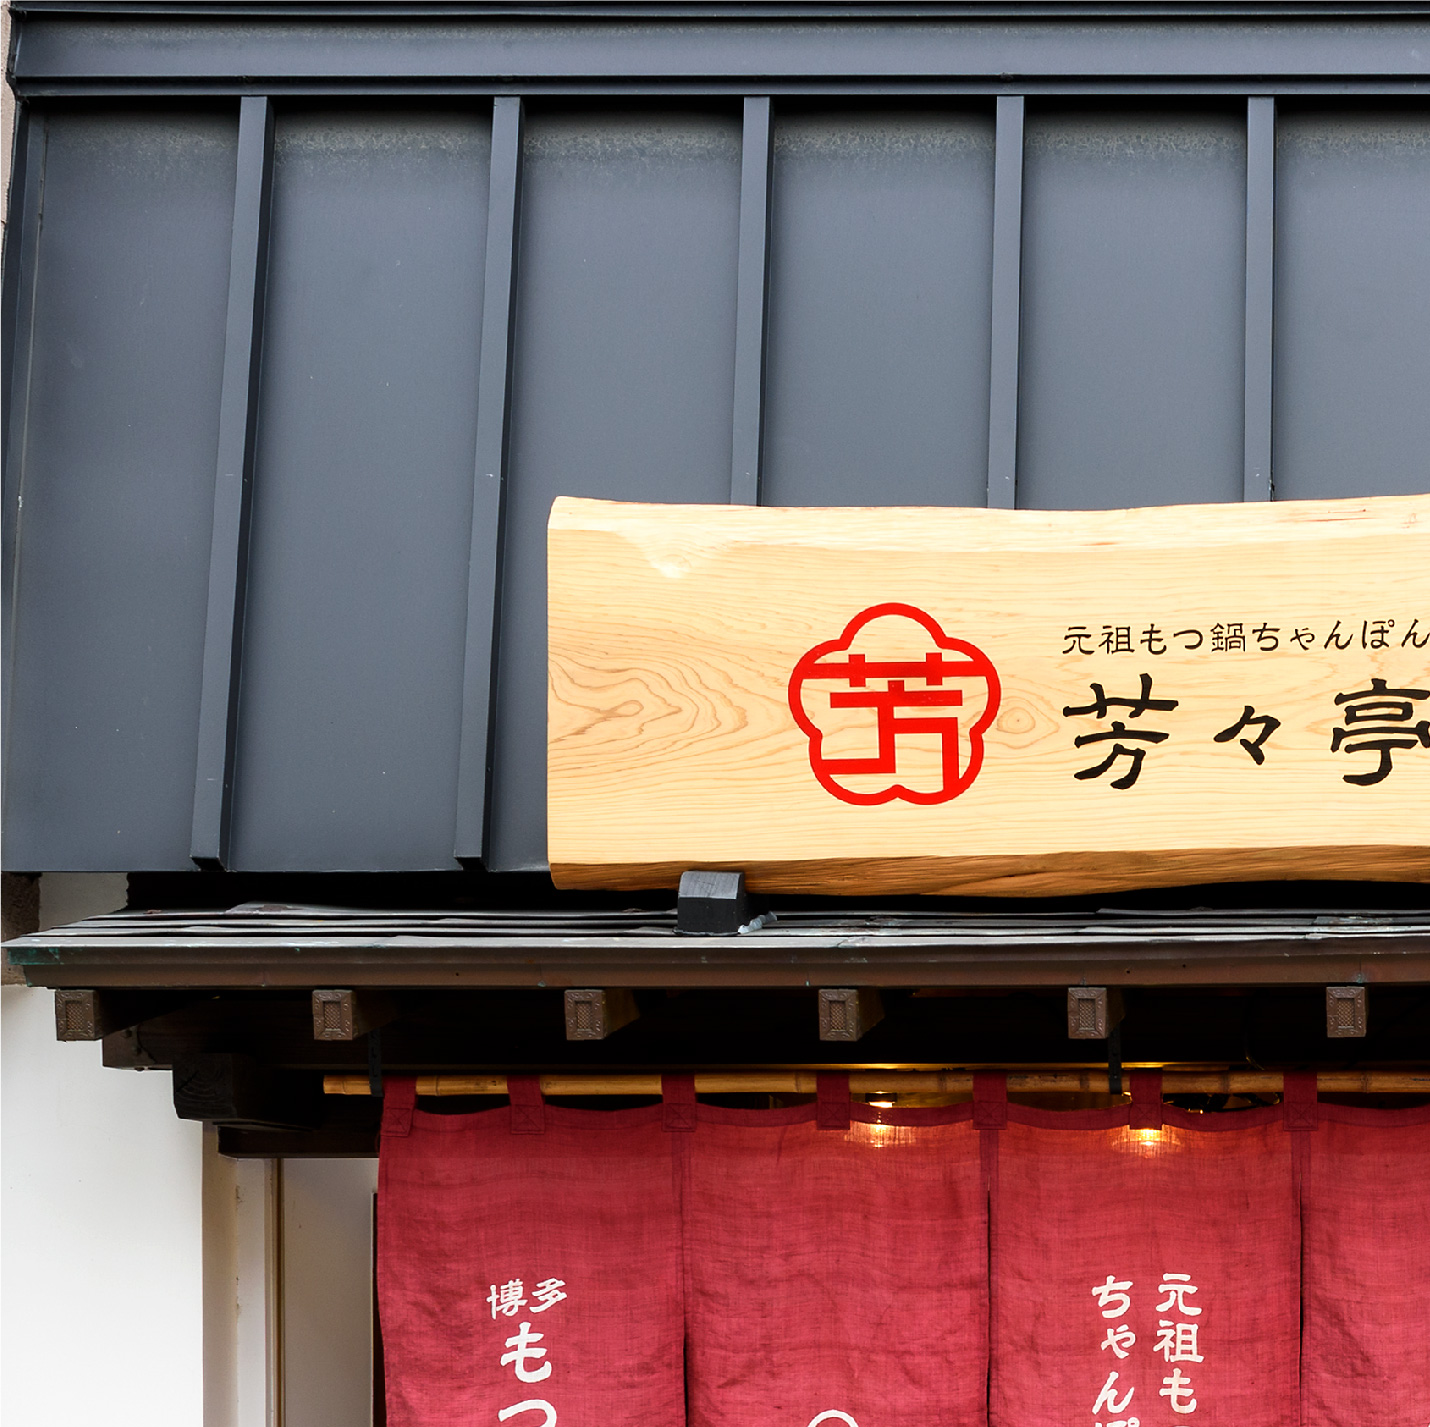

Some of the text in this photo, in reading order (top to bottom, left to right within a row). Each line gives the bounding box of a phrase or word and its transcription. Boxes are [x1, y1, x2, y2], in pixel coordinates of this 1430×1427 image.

[1063, 619, 1430, 655] 元祖もつ鍋ちゃんぽん
[486, 1277, 568, 1320] 博多
